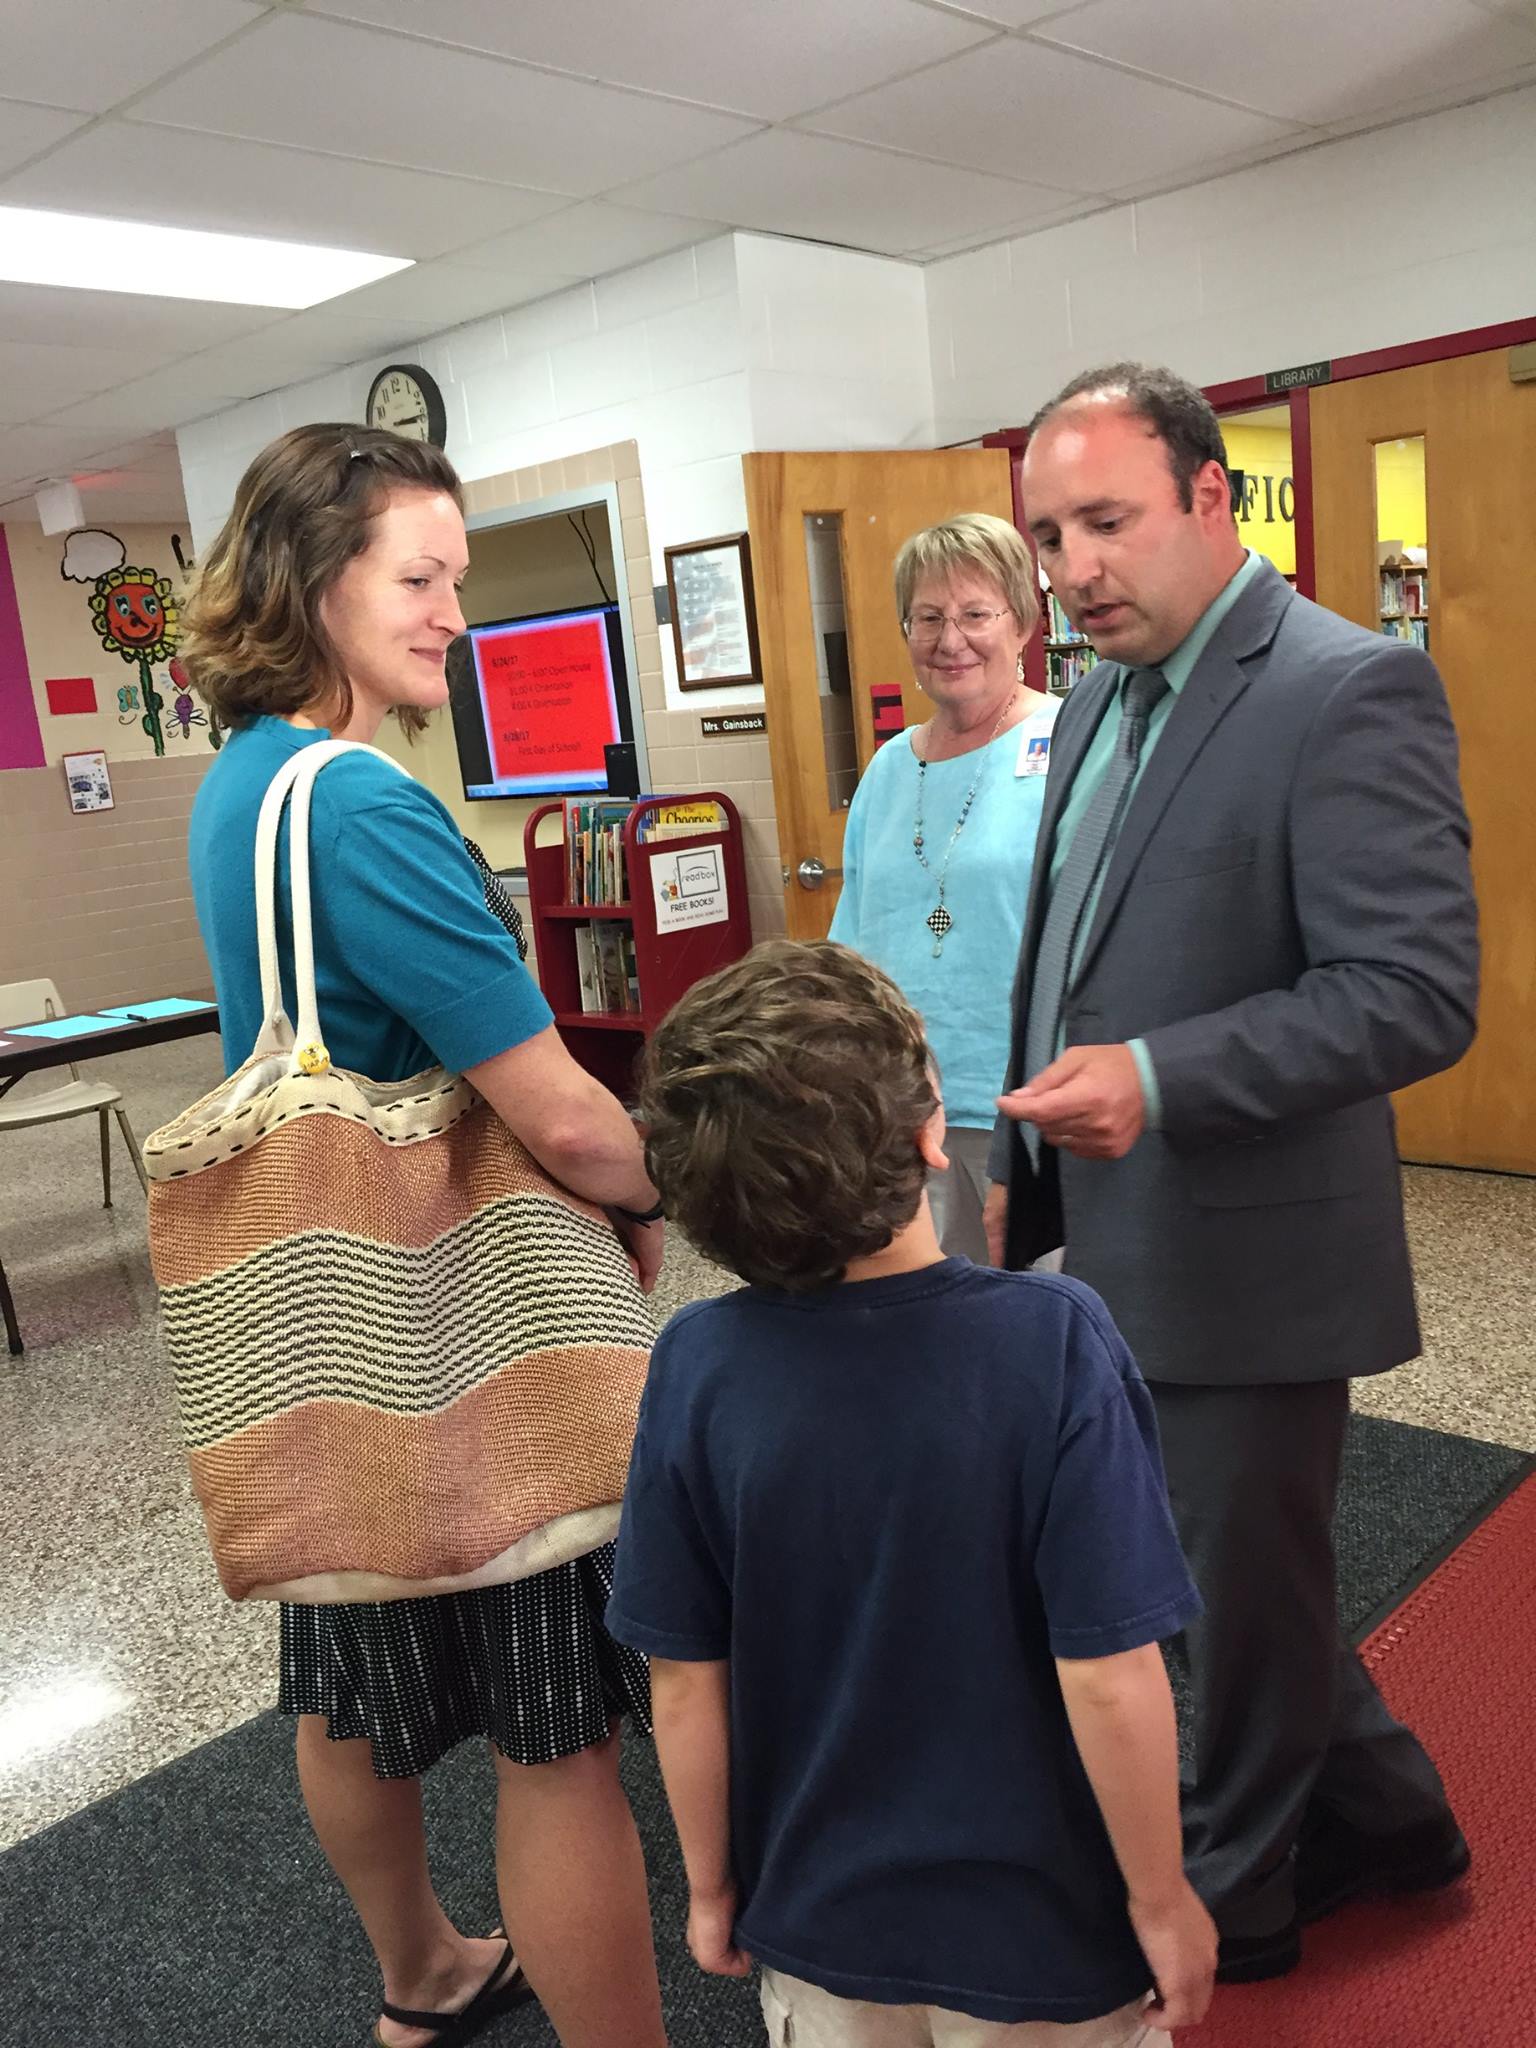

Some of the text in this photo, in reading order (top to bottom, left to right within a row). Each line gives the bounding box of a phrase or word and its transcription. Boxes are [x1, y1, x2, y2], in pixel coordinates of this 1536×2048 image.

[1272, 366, 1322, 388] LIBRARY
[390, 377, 401, 394] 12
[381, 388, 390, 404] 11
[703, 718, 763, 731] Mrs. Gainsback
[670, 897, 714, 912] FREE BOOKS!
